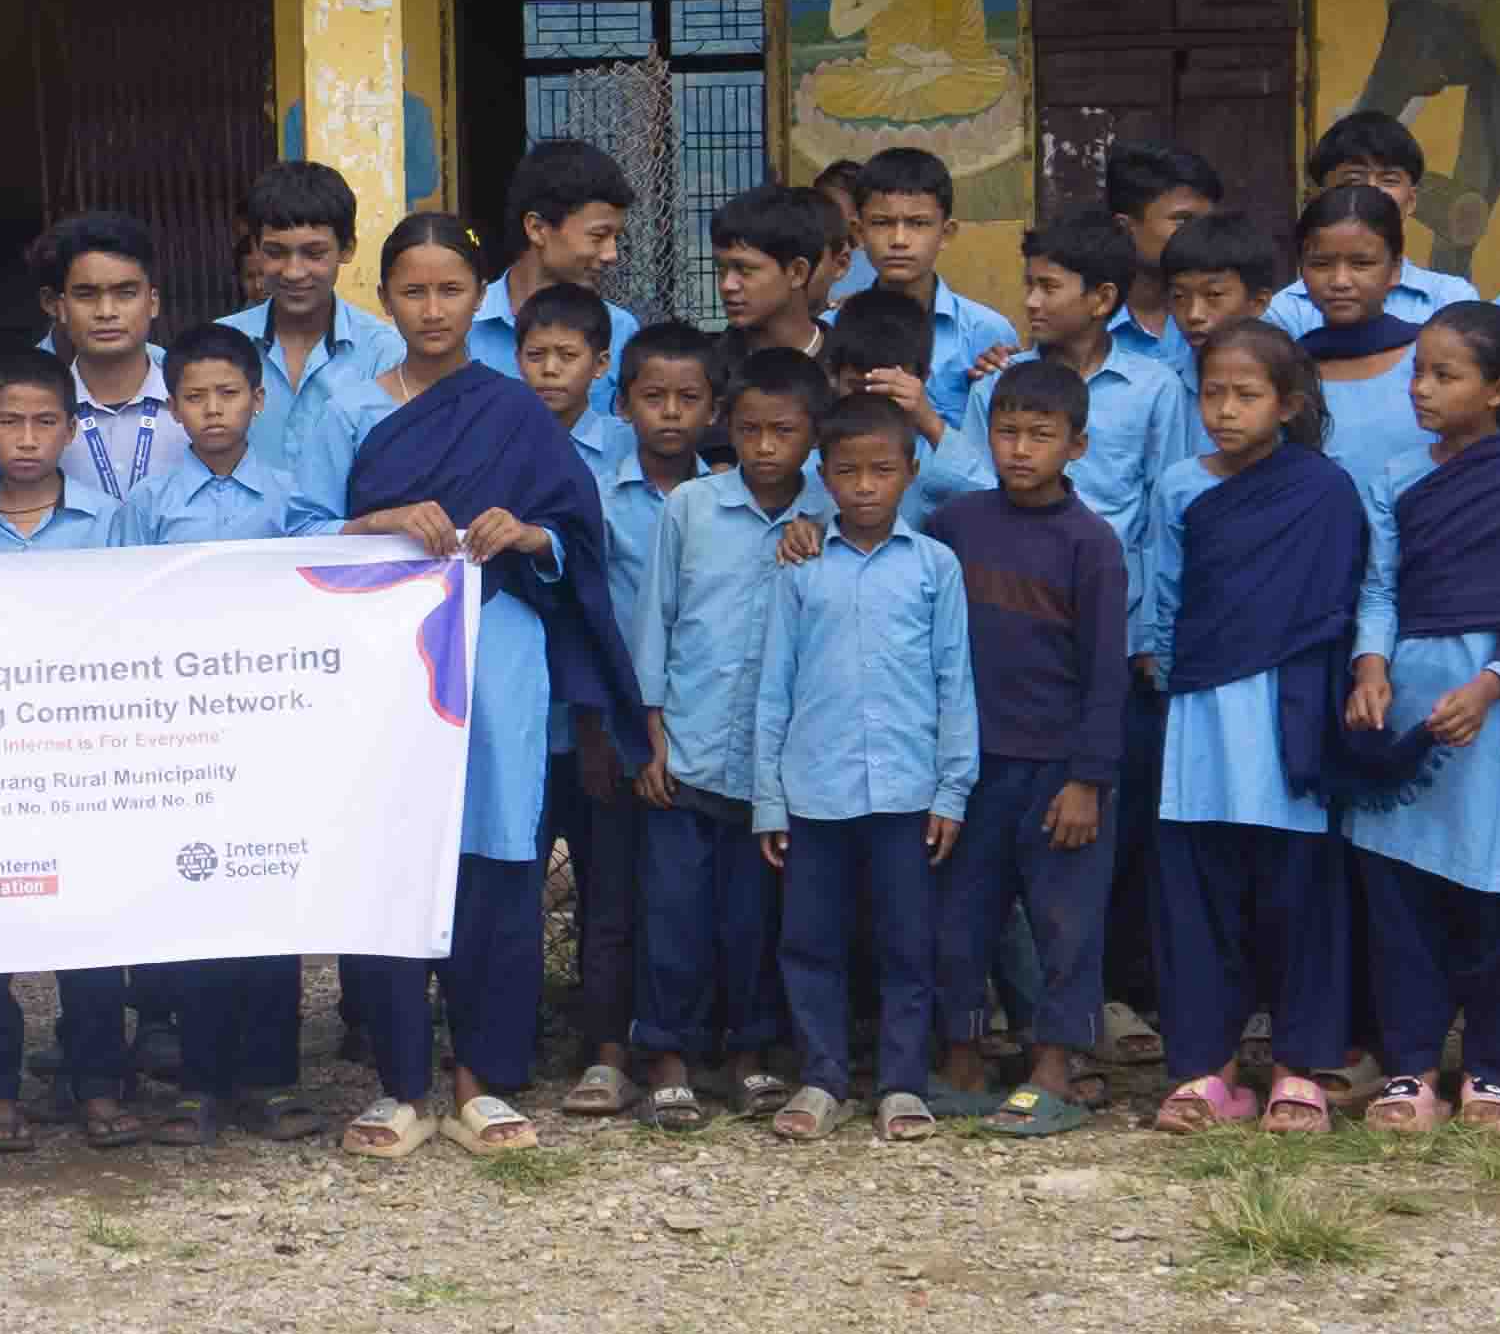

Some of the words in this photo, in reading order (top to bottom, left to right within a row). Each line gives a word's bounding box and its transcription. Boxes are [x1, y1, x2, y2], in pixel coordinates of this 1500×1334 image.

[175, 647, 341, 678] Gathering
[16, 698, 178, 724] Community
[188, 689, 313, 716] Network.
[78, 737, 93, 750] is
[99, 733, 128, 748] For
[53, 770, 107, 788] Rural
[113, 763, 237, 785] Municipality
[18, 802, 46, 816] No.
[111, 794, 157, 810] Ward
[225, 838, 309, 858] Internet
[225, 858, 300, 881] Society
